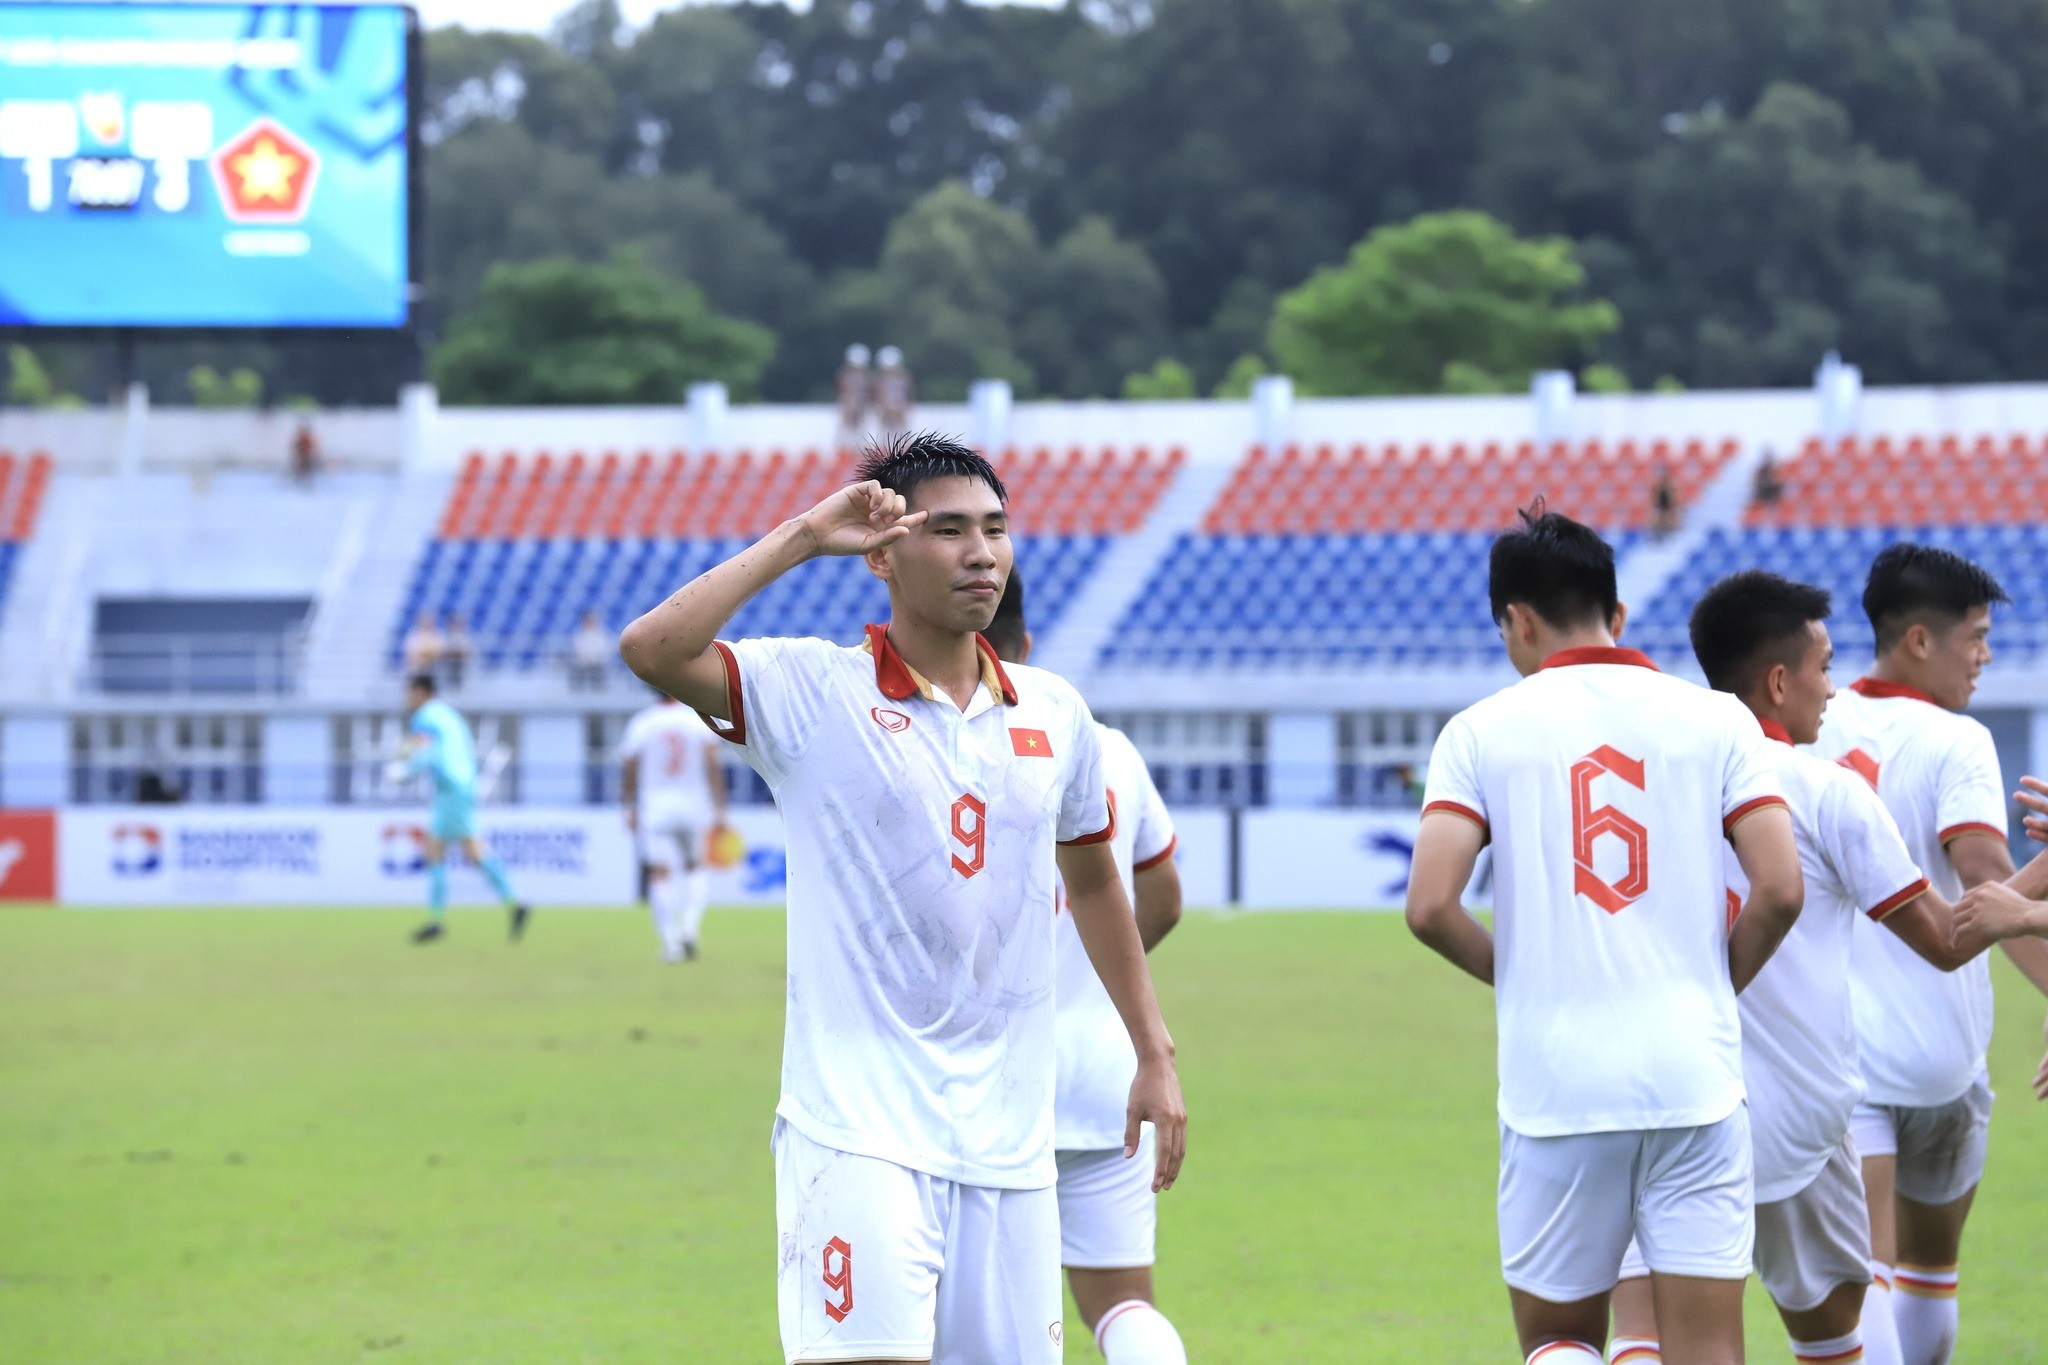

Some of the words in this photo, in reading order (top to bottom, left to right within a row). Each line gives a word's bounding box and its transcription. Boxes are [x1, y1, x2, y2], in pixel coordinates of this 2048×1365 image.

[951, 793, 986, 879] 9
[1571, 744, 1648, 915] 6
[823, 1236, 854, 1323] 9
